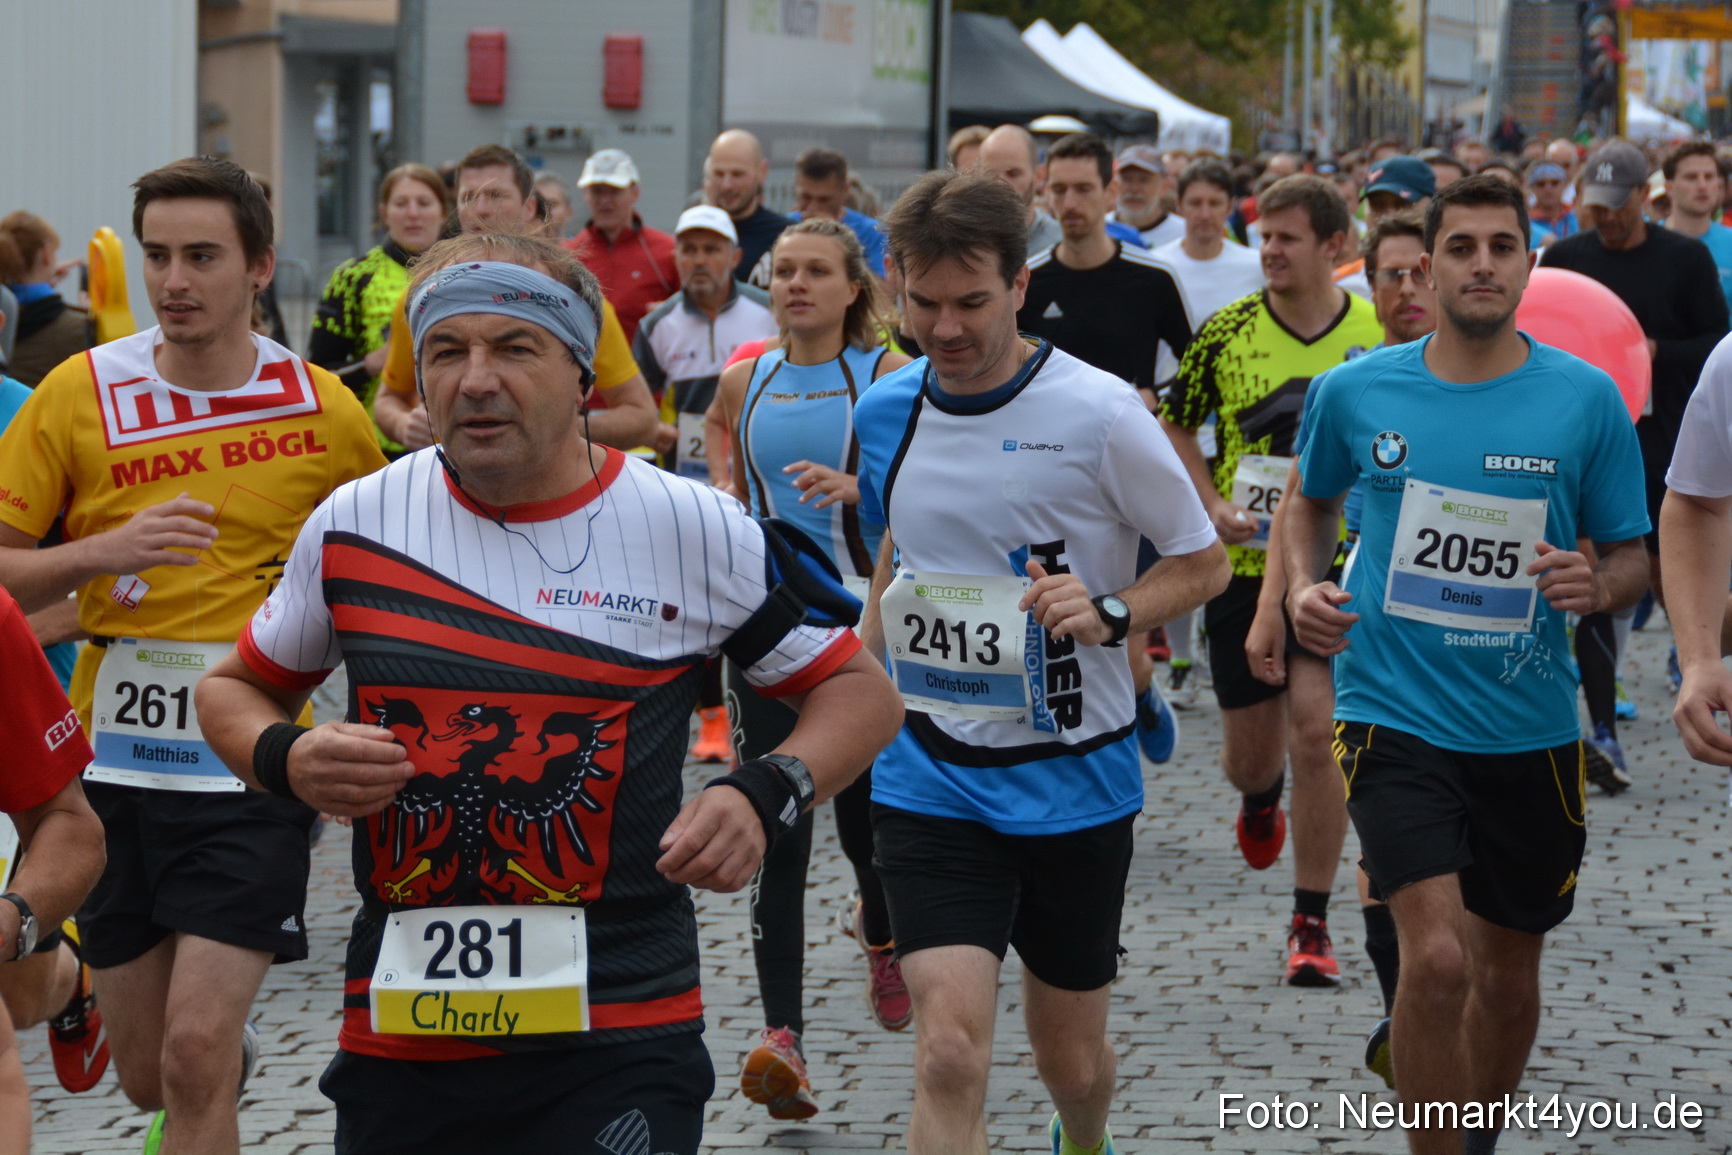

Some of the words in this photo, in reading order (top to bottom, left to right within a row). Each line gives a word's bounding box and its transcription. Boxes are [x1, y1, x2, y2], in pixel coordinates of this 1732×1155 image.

[492, 291, 559, 304] NEUMARKT
[110, 446, 209, 489] MAX
[220, 429, 328, 468] BÖGL
[1483, 454, 1559, 475] BOCK
[1456, 503, 1508, 522] BOCK
[1398, 557, 1405, 566] C
[1413, 528, 1521, 579] 2055
[536, 588, 658, 616] NEUMARKT
[929, 585, 983, 601] BOCK
[1441, 587, 1483, 606] Denis
[605, 614, 631, 624] STARKE
[633, 619, 653, 628] STADT
[904, 613, 1001, 666] 2413
[1030, 539, 1083, 734] HBER
[1443, 632, 1517, 649] Stadtlauf
[151, 650, 206, 667] BOCK
[925, 672, 990, 697] Christoph
[114, 681, 189, 730] 261
[100, 716, 106, 725] D
[133, 743, 199, 764] Matthias
[423, 918, 522, 980] 281
[384, 973, 393, 983] D
[411, 990, 520, 1036] Charly
